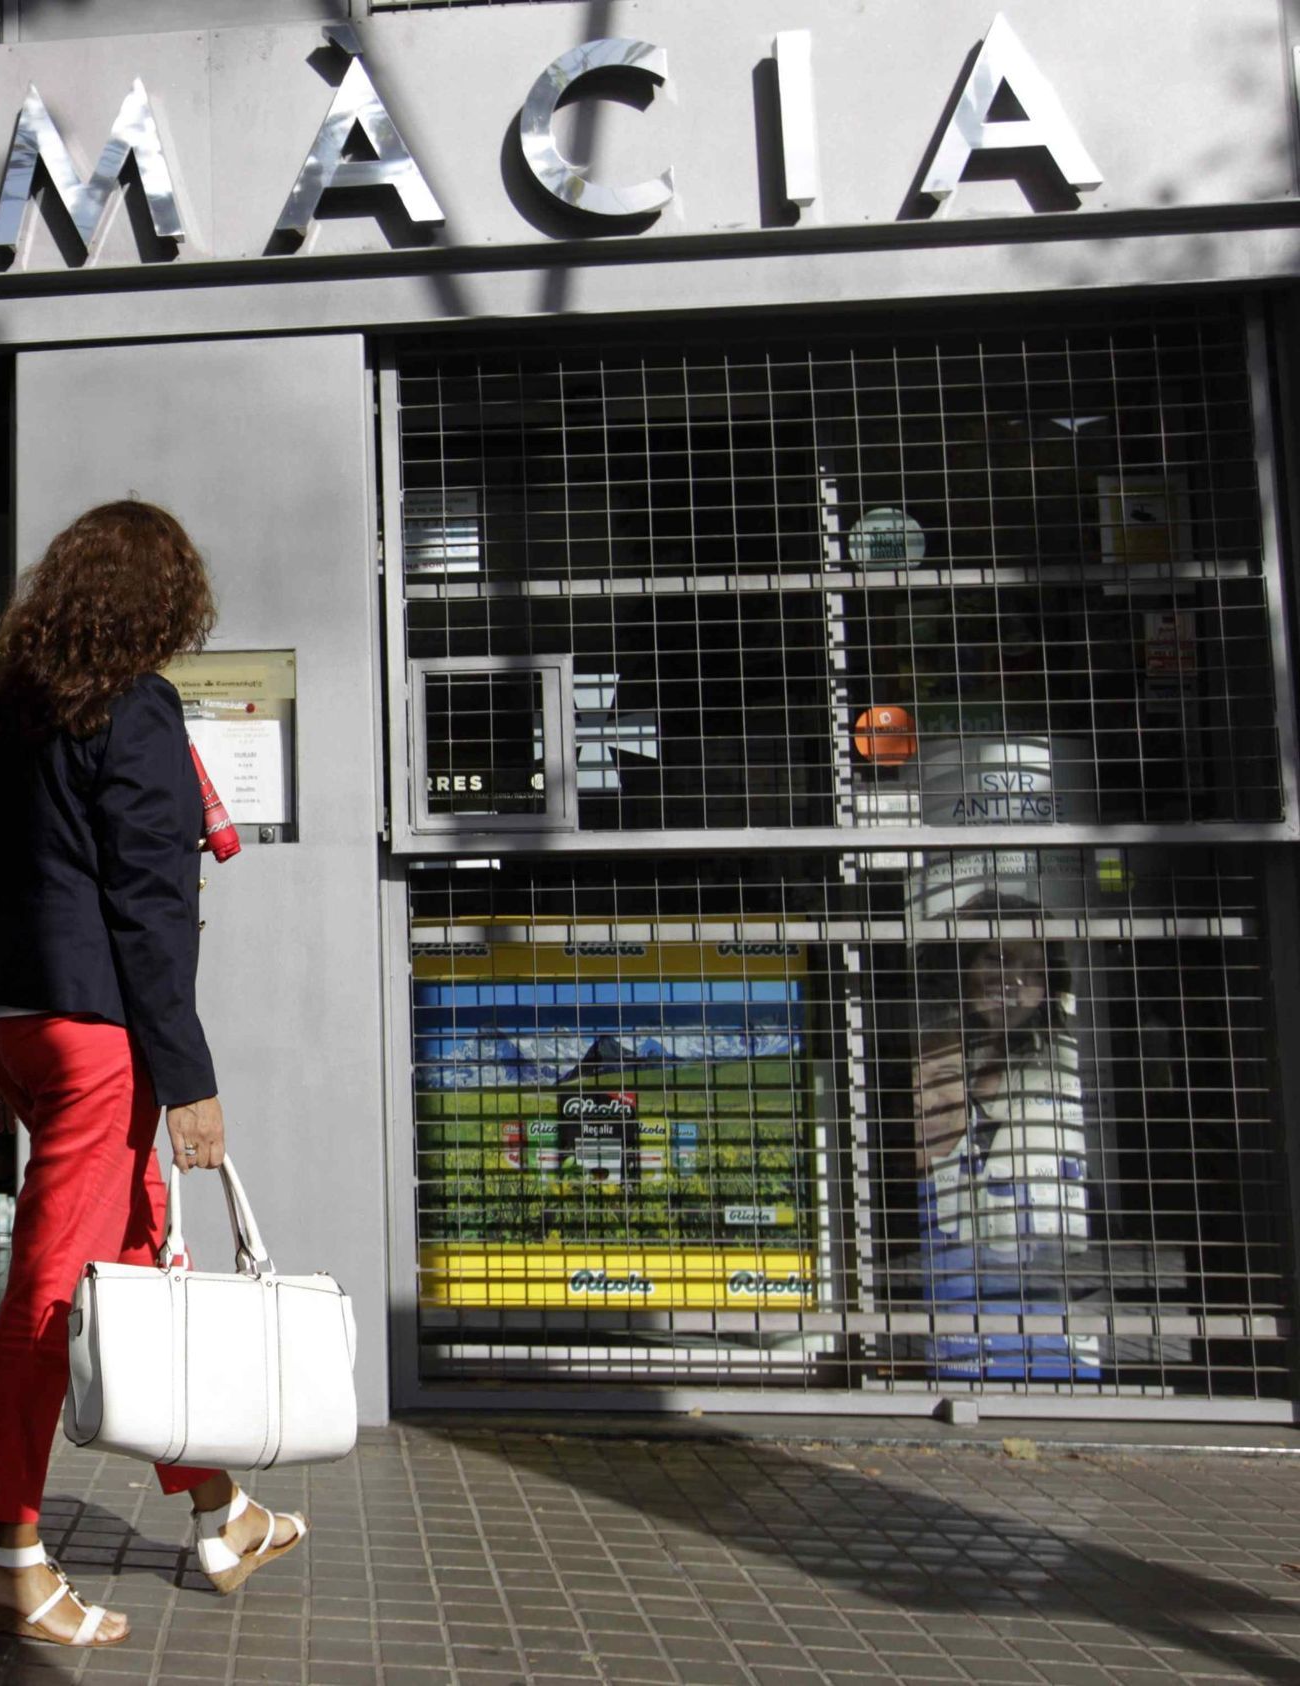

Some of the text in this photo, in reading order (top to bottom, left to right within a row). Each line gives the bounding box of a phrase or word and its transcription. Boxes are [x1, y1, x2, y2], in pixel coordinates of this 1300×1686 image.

[983, 773, 1035, 791] SVR
[953, 798, 1064, 818] ANTI-AGE
[563, 1096, 632, 1119] Ricola
[583, 1124, 614, 1136] Regaliz
[637, 1123, 666, 1135] icola
[729, 1210, 771, 1222] Ricola
[570, 1270, 653, 1293] Ricola
[728, 1271, 813, 1294] Ricola
